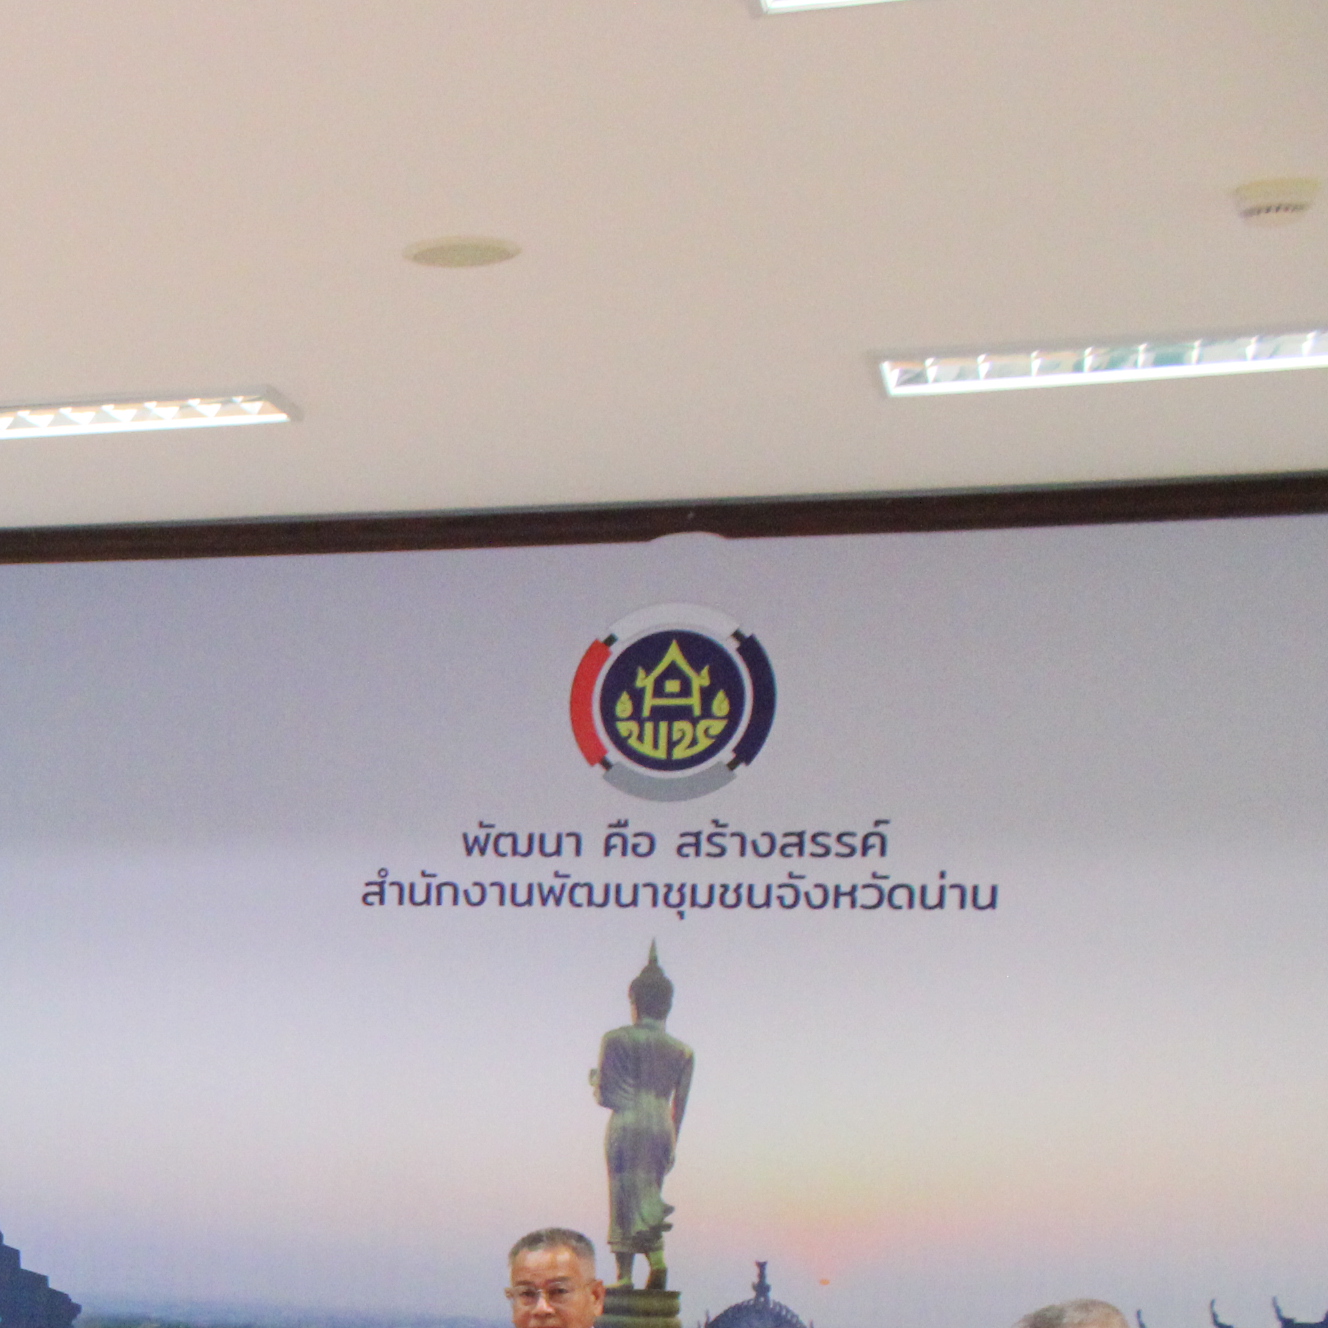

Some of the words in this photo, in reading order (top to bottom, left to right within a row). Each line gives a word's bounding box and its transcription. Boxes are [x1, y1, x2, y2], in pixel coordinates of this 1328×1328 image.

[461, 820, 583, 859] พัฒนา
[603, 818, 656, 858] คือ
[675, 818, 890, 859] สร้างสรรค์
[360, 867, 999, 920] สำนักงานพัฒนาชุมชนจังหวัดน่าน
